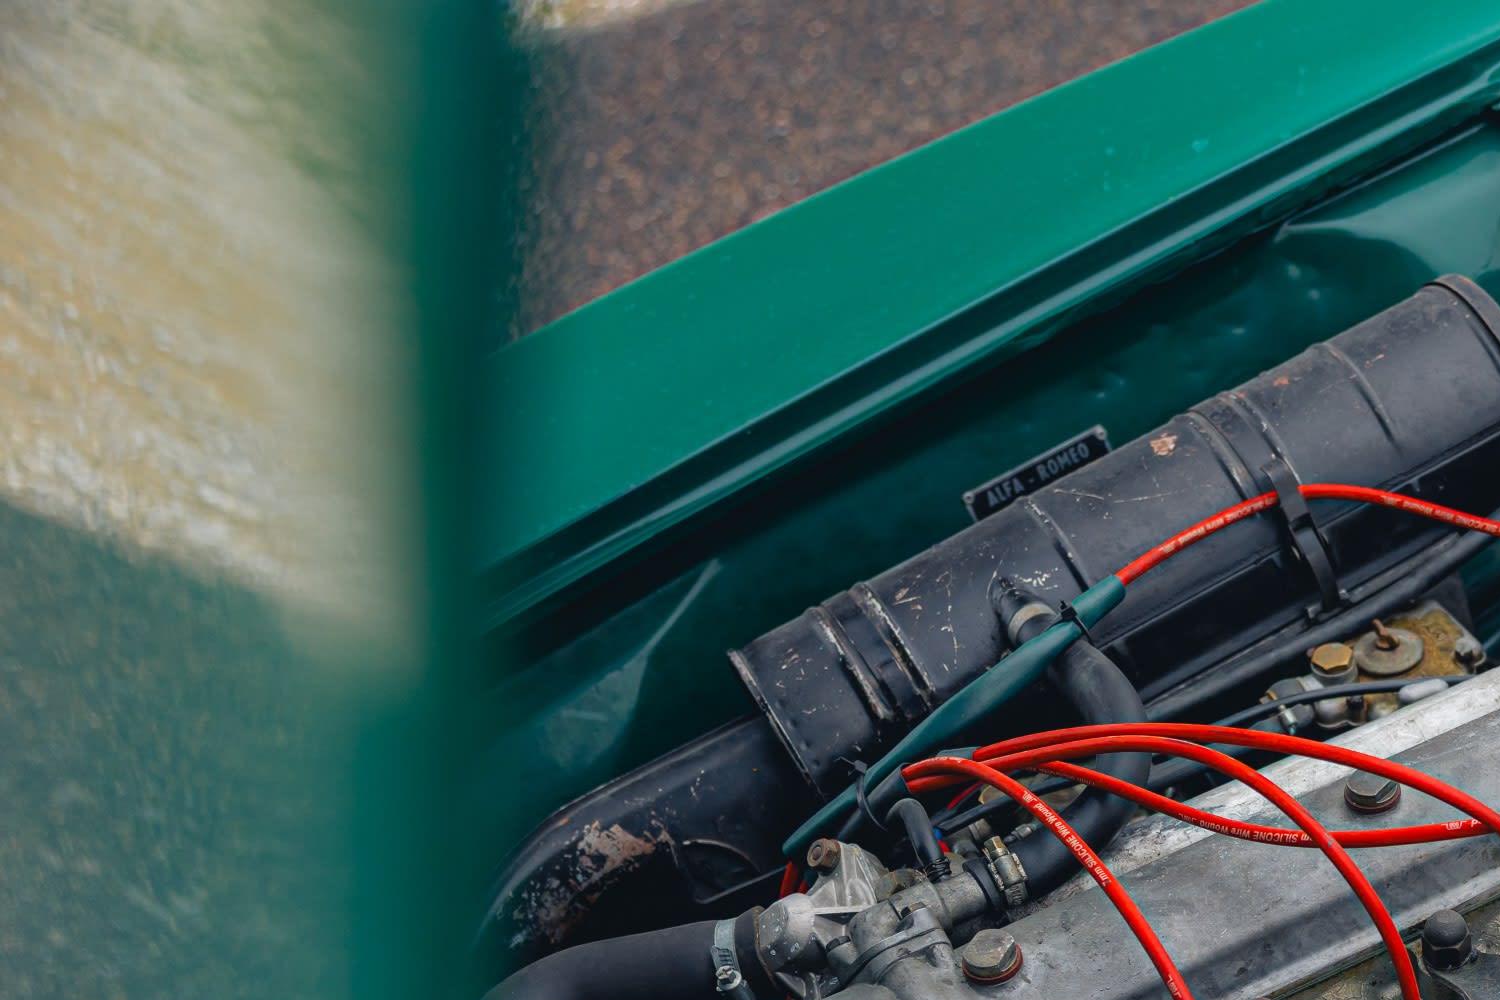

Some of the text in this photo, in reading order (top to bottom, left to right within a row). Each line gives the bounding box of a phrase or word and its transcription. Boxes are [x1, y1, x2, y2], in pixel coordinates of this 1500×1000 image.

[986, 477, 1024, 508] ALFA
[1036, 443, 1089, 481] ROMEO
[1034, 803, 1056, 824] Wound
[1055, 821, 1070, 838] Wire
[1199, 820, 1230, 833] Wound
[1230, 827, 1251, 838] Wire
[1253, 829, 1299, 844] SILICONE
[1067, 835, 1097, 869] SILICONE
